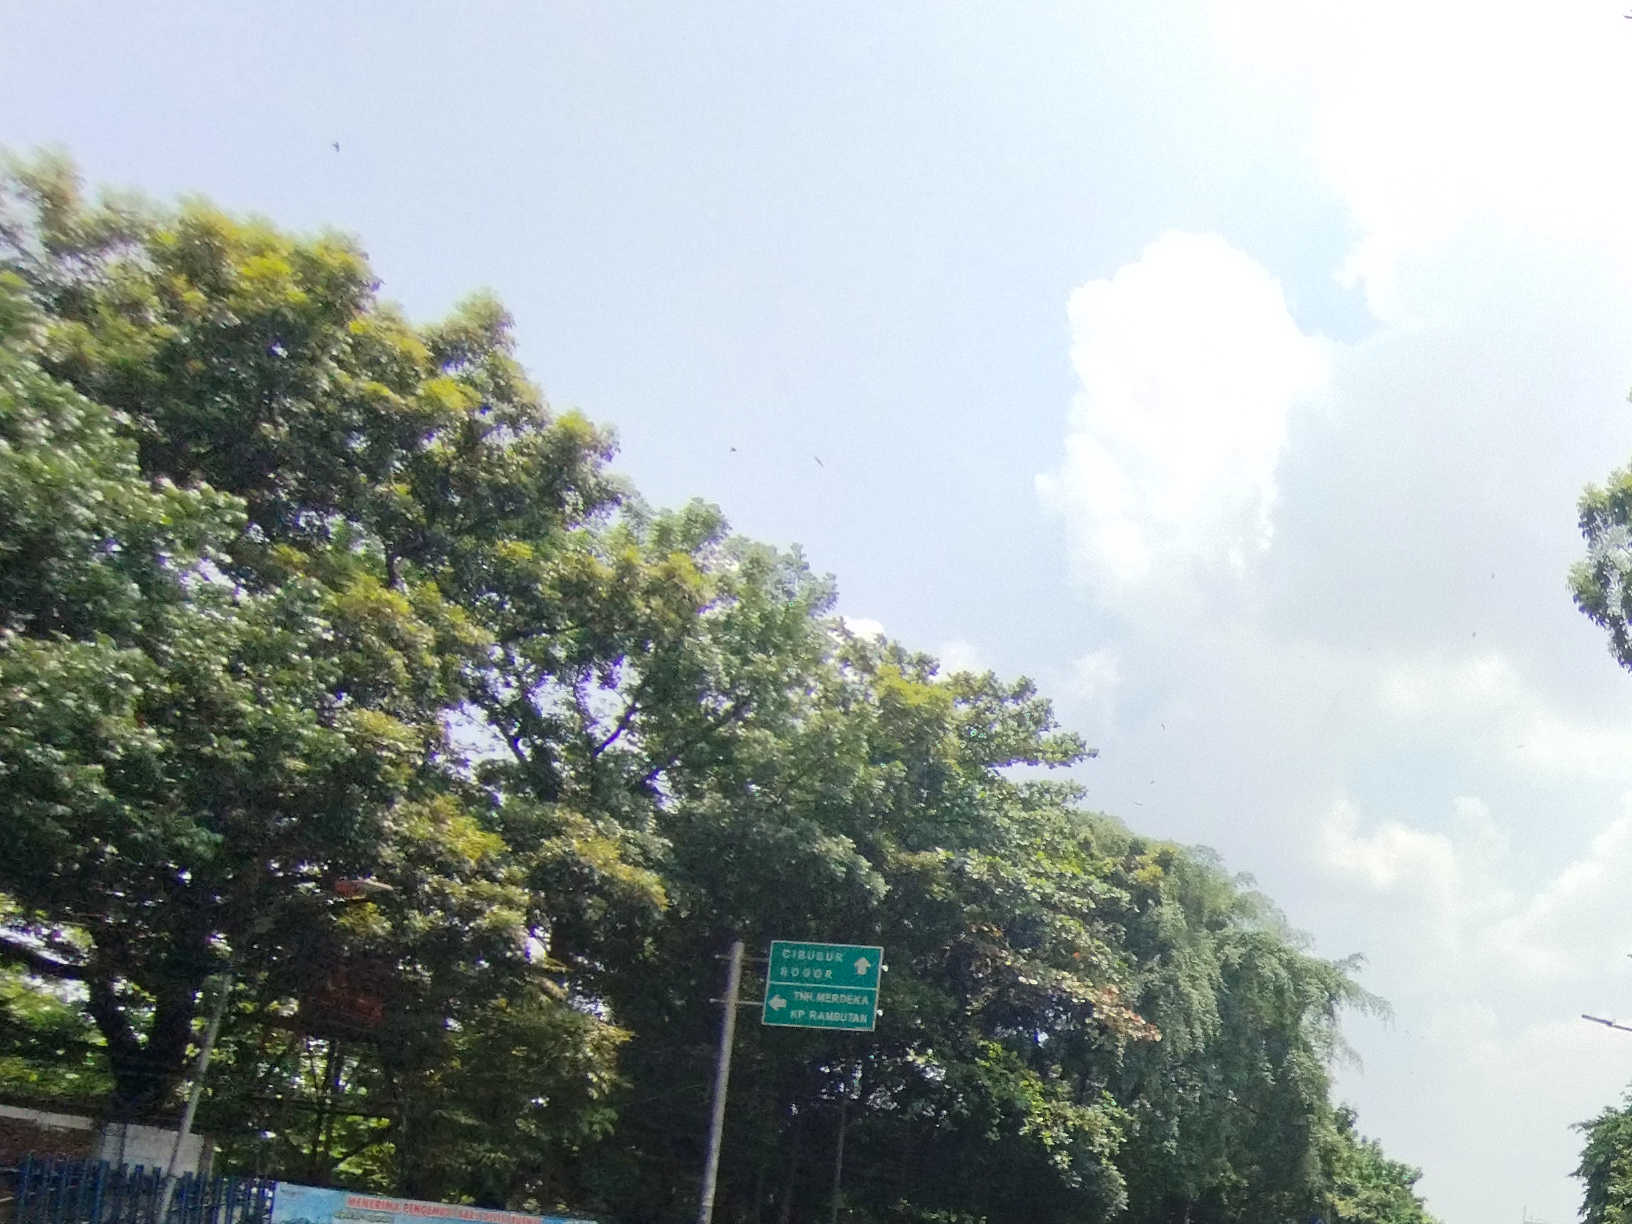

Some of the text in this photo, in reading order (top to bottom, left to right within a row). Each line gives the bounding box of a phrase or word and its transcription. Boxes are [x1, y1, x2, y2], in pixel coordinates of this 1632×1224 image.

[782, 949, 843, 962] CIBUBUR
[780, 967, 832, 979] BOGOR
[816, 992, 869, 1006] MERDEKA
[809, 1010, 869, 1024] RAMBUTAN
